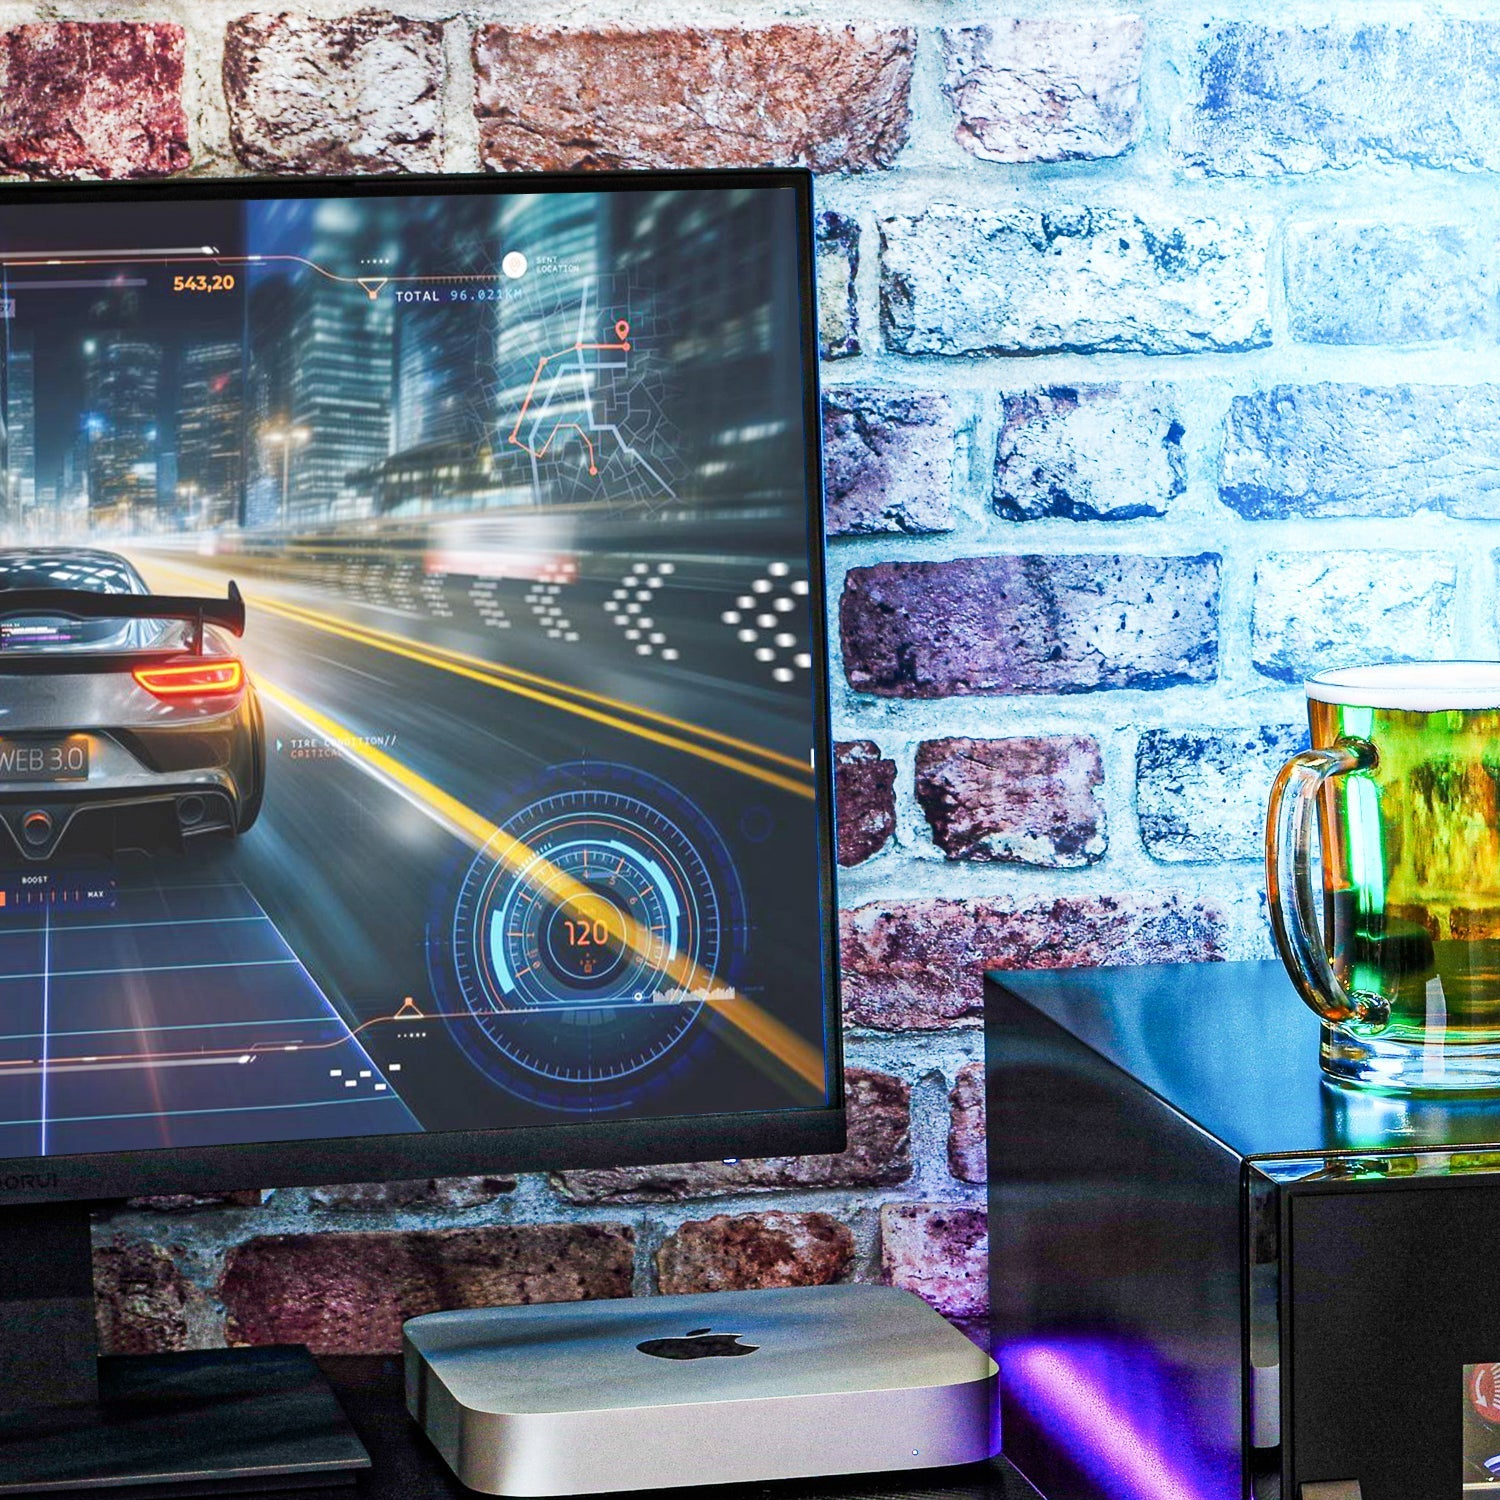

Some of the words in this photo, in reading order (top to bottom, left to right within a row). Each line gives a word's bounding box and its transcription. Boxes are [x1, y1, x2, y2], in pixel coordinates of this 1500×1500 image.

[174, 275, 234, 293] 543,20
[395, 291, 439, 302] TOTAL
[290, 740, 316, 749] TIRE
[0, 749, 44, 772] WEB
[51, 747, 83, 771] 3.0
[22, 876, 48, 884] BOOST
[564, 919, 609, 946] 120
[0, 1172, 57, 1191] ORUI
